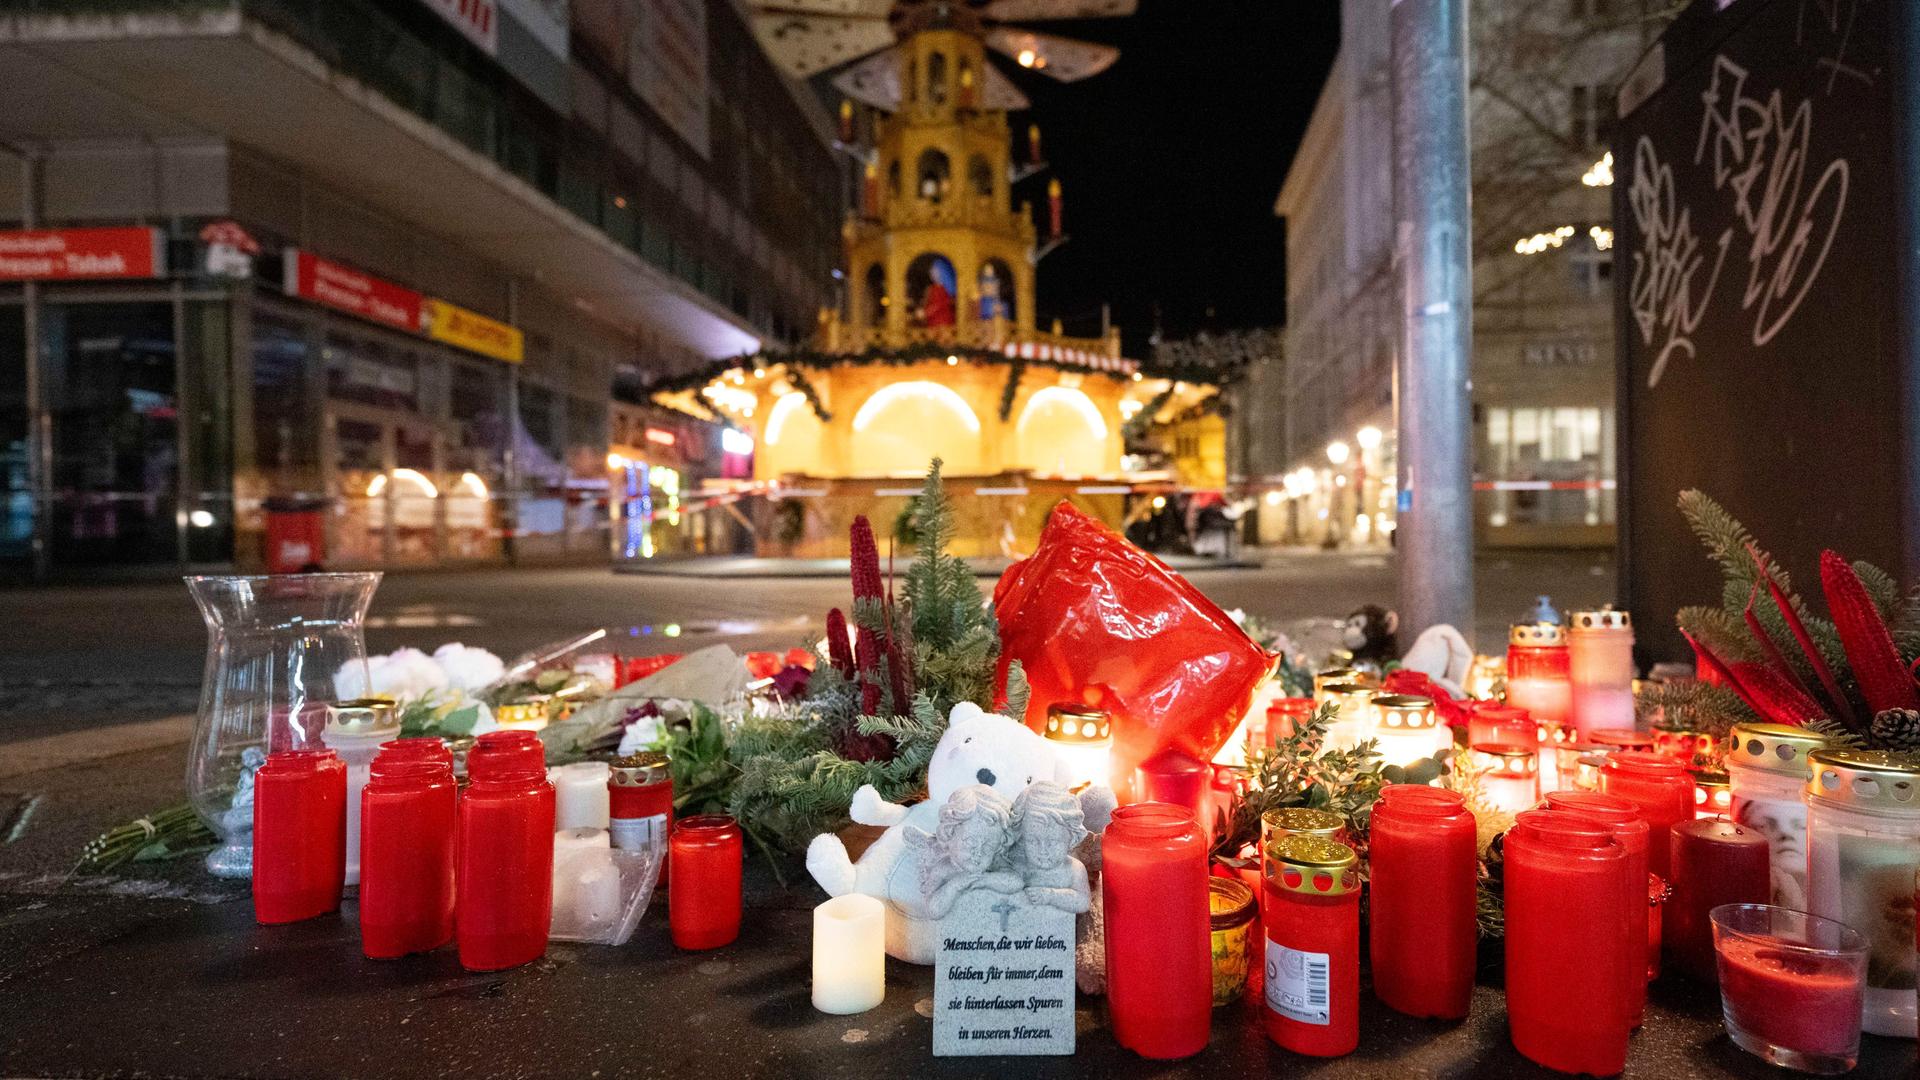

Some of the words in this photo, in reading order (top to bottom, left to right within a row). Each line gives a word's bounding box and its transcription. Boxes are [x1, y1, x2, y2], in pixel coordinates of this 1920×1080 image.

[1014, 936, 1033, 951] wir
[1034, 935, 1067, 951] lieben,
[948, 965, 983, 980] bleiben
[983, 966, 1004, 984] für
[947, 997, 962, 1010] sie
[964, 995, 1025, 1010] hinterlassen
[1026, 996, 1063, 1013] Spuren
[958, 1026, 969, 1040] in
[971, 1029, 1011, 1040] unseren
[1012, 1026, 1053, 1040] Herzen.
